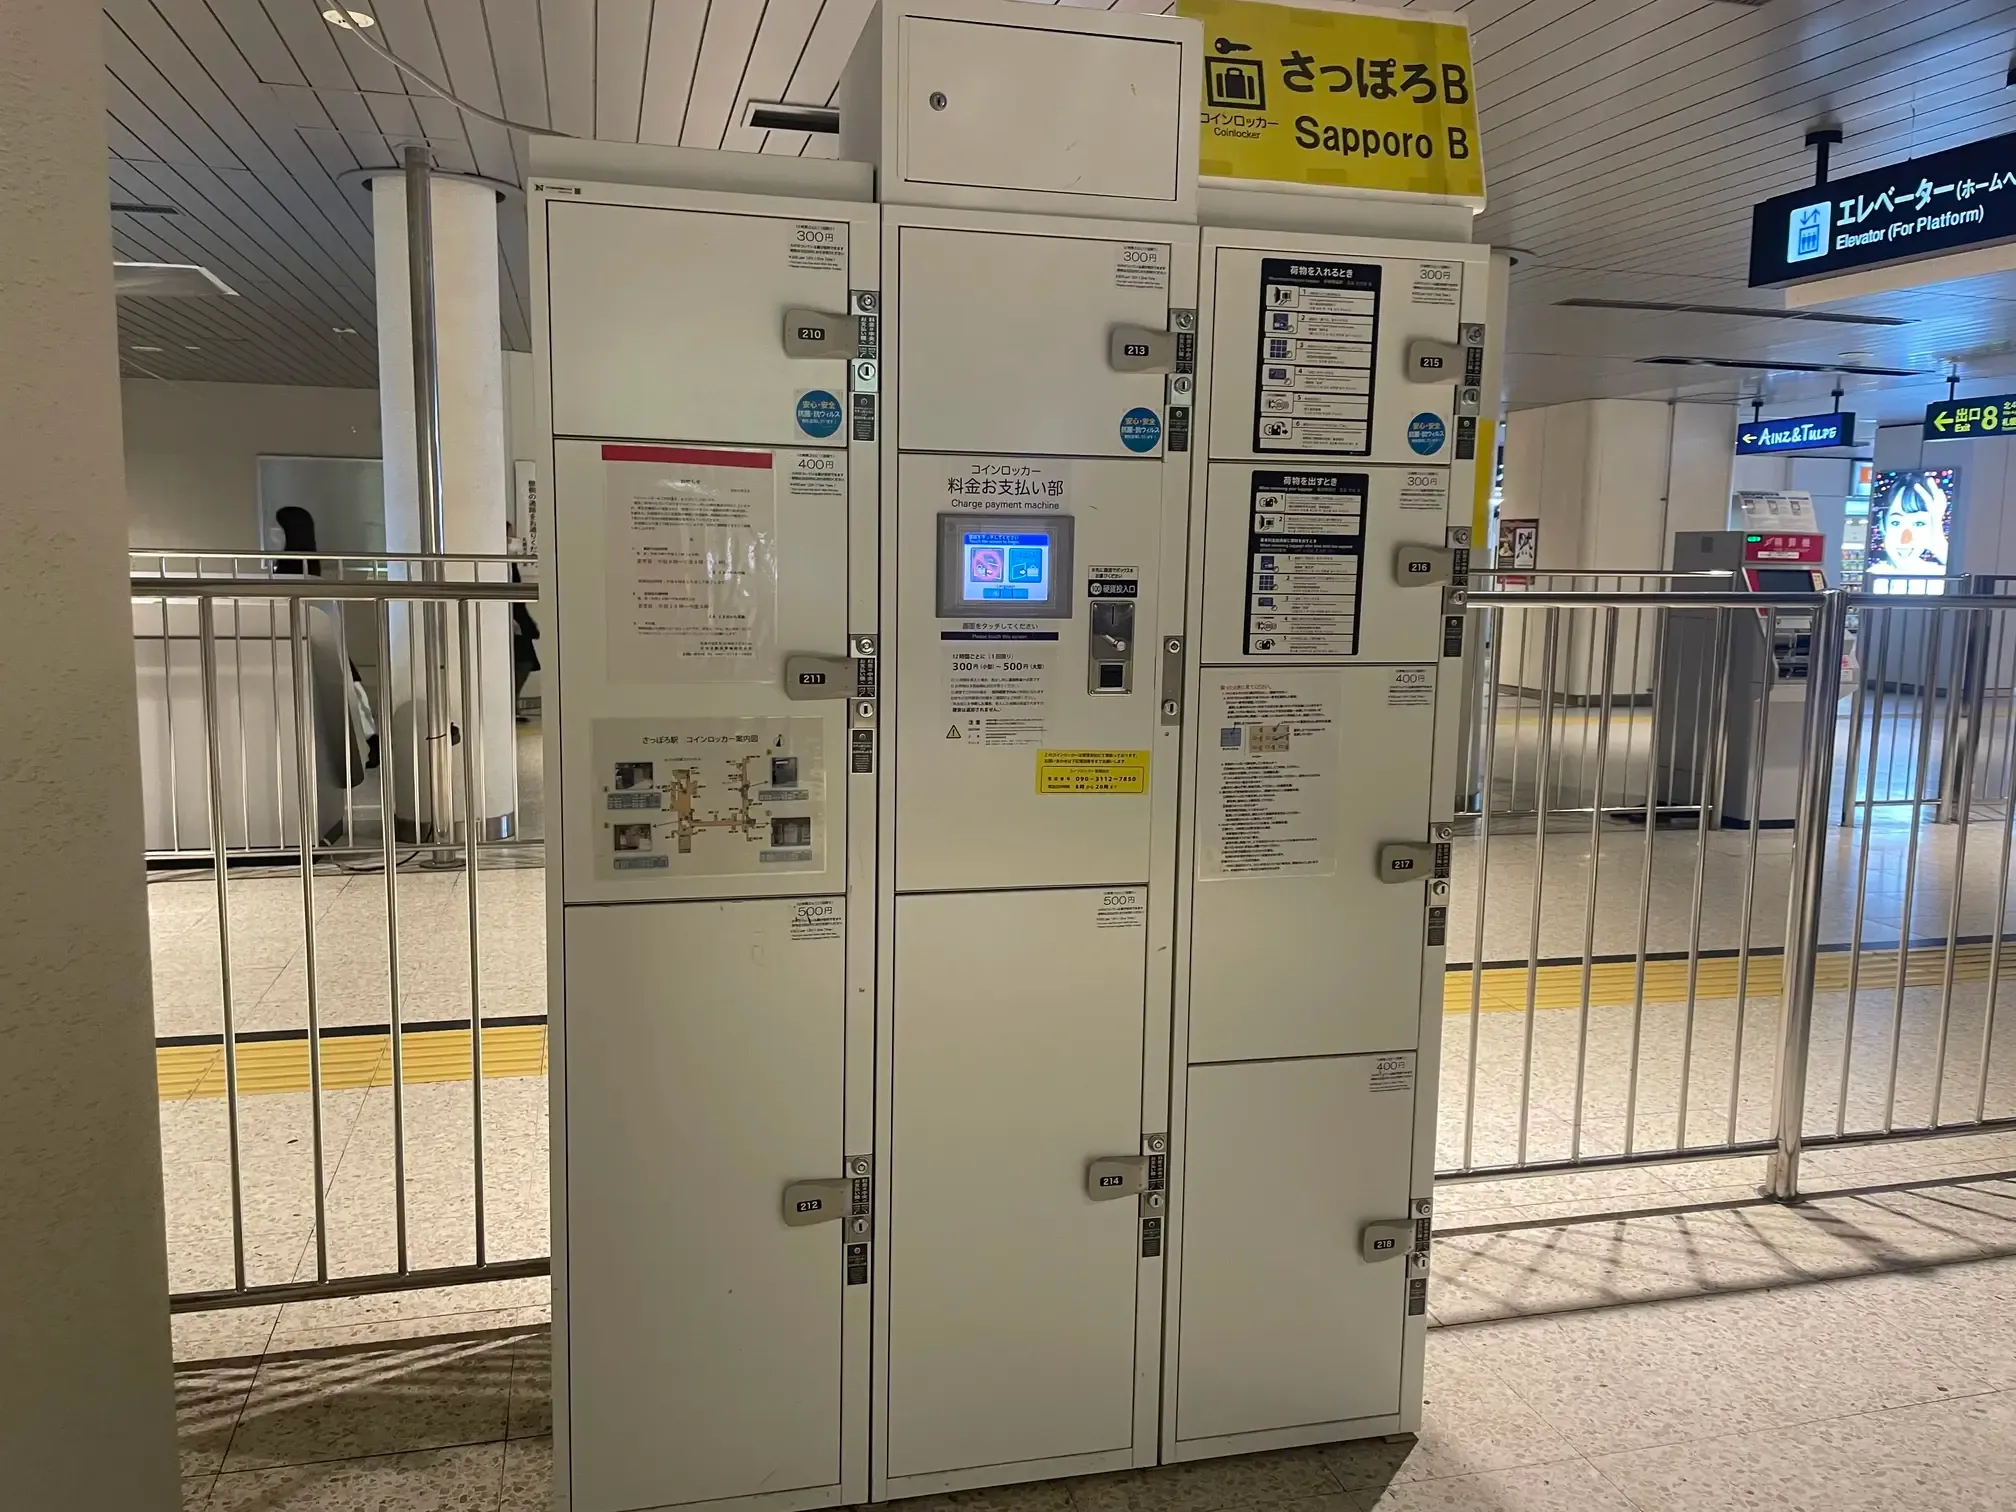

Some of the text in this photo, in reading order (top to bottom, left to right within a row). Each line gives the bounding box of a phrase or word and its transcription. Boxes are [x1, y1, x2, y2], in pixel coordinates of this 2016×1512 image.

[1200, 112, 1279, 129] コインロッカー
[1214, 127, 1261, 140] Coinlocker
[1295, 115, 1470, 160] Sapporo B
[1836, 204, 1984, 250] Elevator (For Platform)
[796, 230, 834, 242] 300円
[1124, 251, 1157, 262] 300円
[1290, 266, 1354, 278] 荷物を入れるとき
[1420, 269, 1450, 280] 300円
[802, 329, 821, 339] 210
[1128, 346, 1146, 354] 213
[1423, 358, 1440, 367] 215
[1956, 406, 1998, 430] 出口 8
[798, 459, 834, 470] 400円
[970, 464, 1042, 476] コインロッカー
[1284, 476, 1338, 486] 荷物を出すとき
[1408, 476, 1438, 486] 300円
[947, 478, 1064, 496] 料金お支払い部
[951, 499, 1060, 510] Charge payment machine
[1411, 563, 1428, 572] 216
[804, 674, 821, 683] 211
[1396, 674, 1425, 683] 400円
[1104, 896, 1135, 906] 500円
[798, 906, 832, 916] 500円
[1376, 1061, 1405, 1070] 400円
[1103, 1178, 1119, 1186] 214
[800, 1201, 818, 1211] 212
